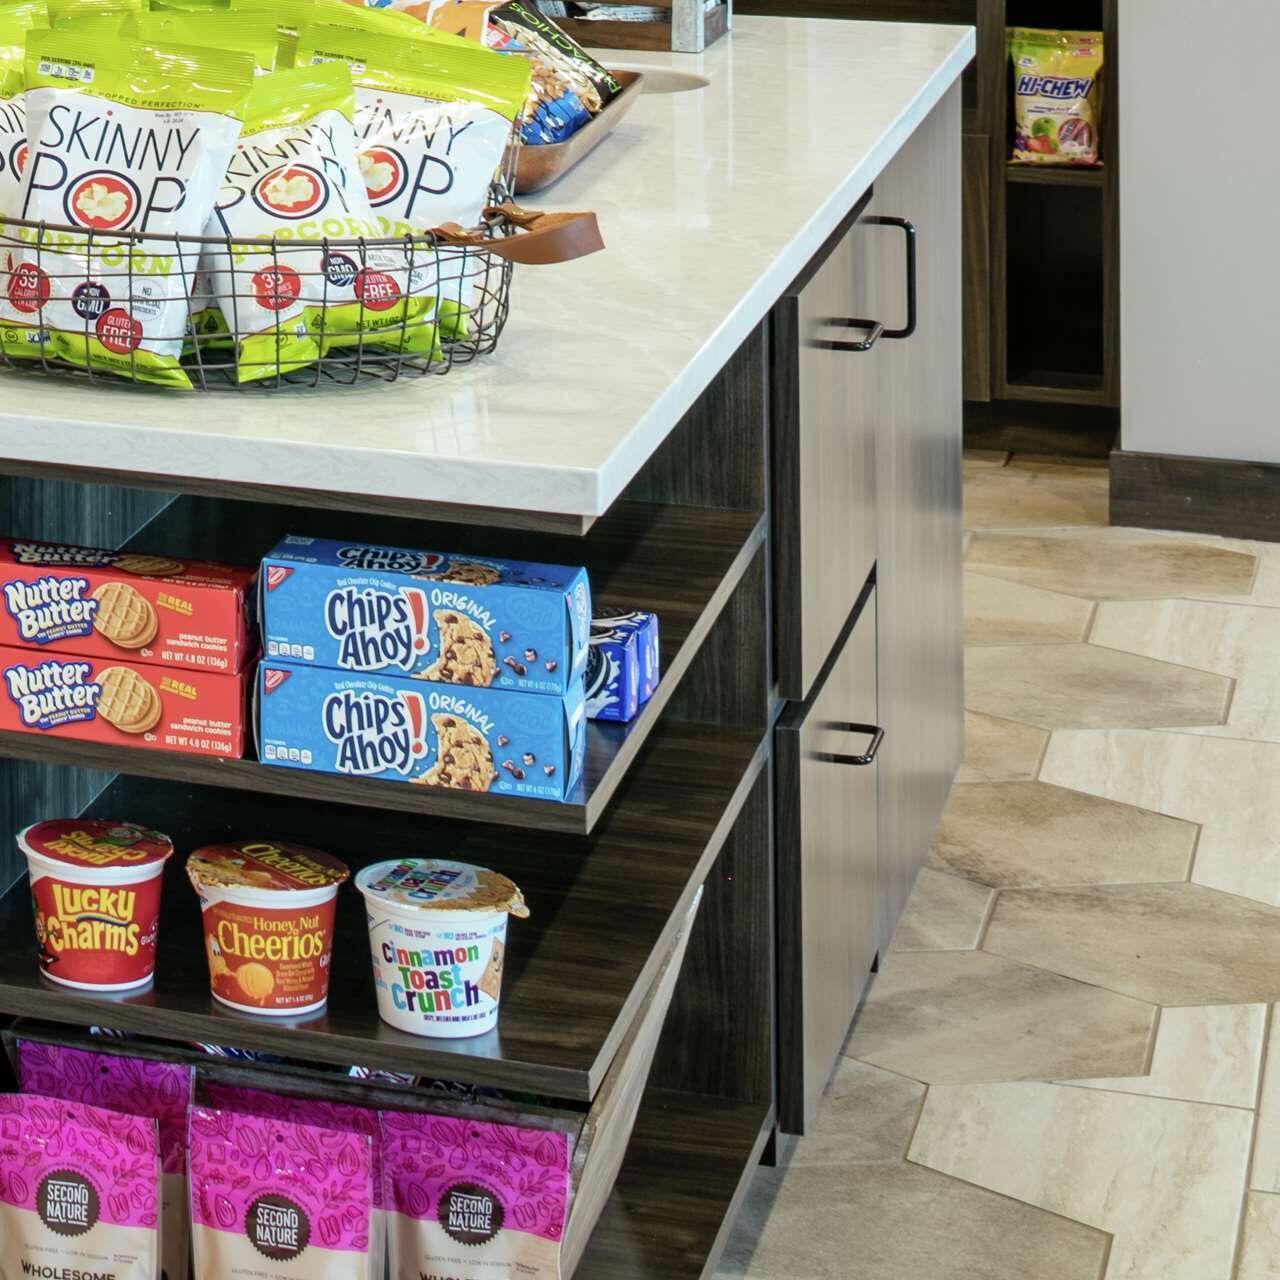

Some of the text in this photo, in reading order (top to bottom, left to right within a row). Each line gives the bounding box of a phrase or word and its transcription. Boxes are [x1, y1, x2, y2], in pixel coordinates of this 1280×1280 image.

[1017, 76, 1093, 99] HI-CHEW
[141, 99, 204, 111] PERFECTION
[40, 104, 202, 172] SKINNY
[22, 150, 190, 245] POP
[215, 156, 351, 240] POP
[330, 256, 343, 265] NON
[328, 265, 354, 280] GMO
[142, 287, 152, 295] NO
[364, 283, 393, 303] FREE
[339, 547, 422, 563] Chips
[4, 577, 86, 613] Nutter
[168, 596, 192, 612] REAL
[17, 599, 97, 638] Butter
[328, 590, 408, 636] Chips
[431, 588, 497, 631] ORIGINAL
[167, 639, 227, 652] sandwich cookies
[179, 633, 228, 645] peanut butter
[162, 651, 228, 669] NET WT 4.8 OZ (136g)
[7, 663, 89, 699] Nutter
[171, 680, 197, 696] REAL
[19, 684, 100, 723] Butter
[429, 692, 496, 735] ORIGINAL
[183, 717, 232, 729] peanut butter
[326, 694, 406, 740] Chips
[171, 723, 231, 736] sandwich cookies
[165, 736, 232, 753] NET WT 4.8 OZ (136g)
[241, 842, 333, 887] Cheerios
[51, 883, 137, 923] Lucky
[47, 916, 139, 956] Charms
[254, 916, 320, 934] Honey Nut
[218, 919, 324, 961] Cheerios
[382, 941, 479, 968] Cinnamon
[398, 963, 464, 990] Toast
[392, 980, 480, 1013] Crunch
[47, 1184, 89, 1203] SECOND
[46, 1201, 88, 1222] NATURE
[256, 1206, 299, 1228] SECOND
[449, 1197, 493, 1215] SECOND
[448, 1214, 492, 1232] NATURE
[256, 1225, 299, 1246] NATURE
[21, 1258, 116, 1280] WHOLESOME
